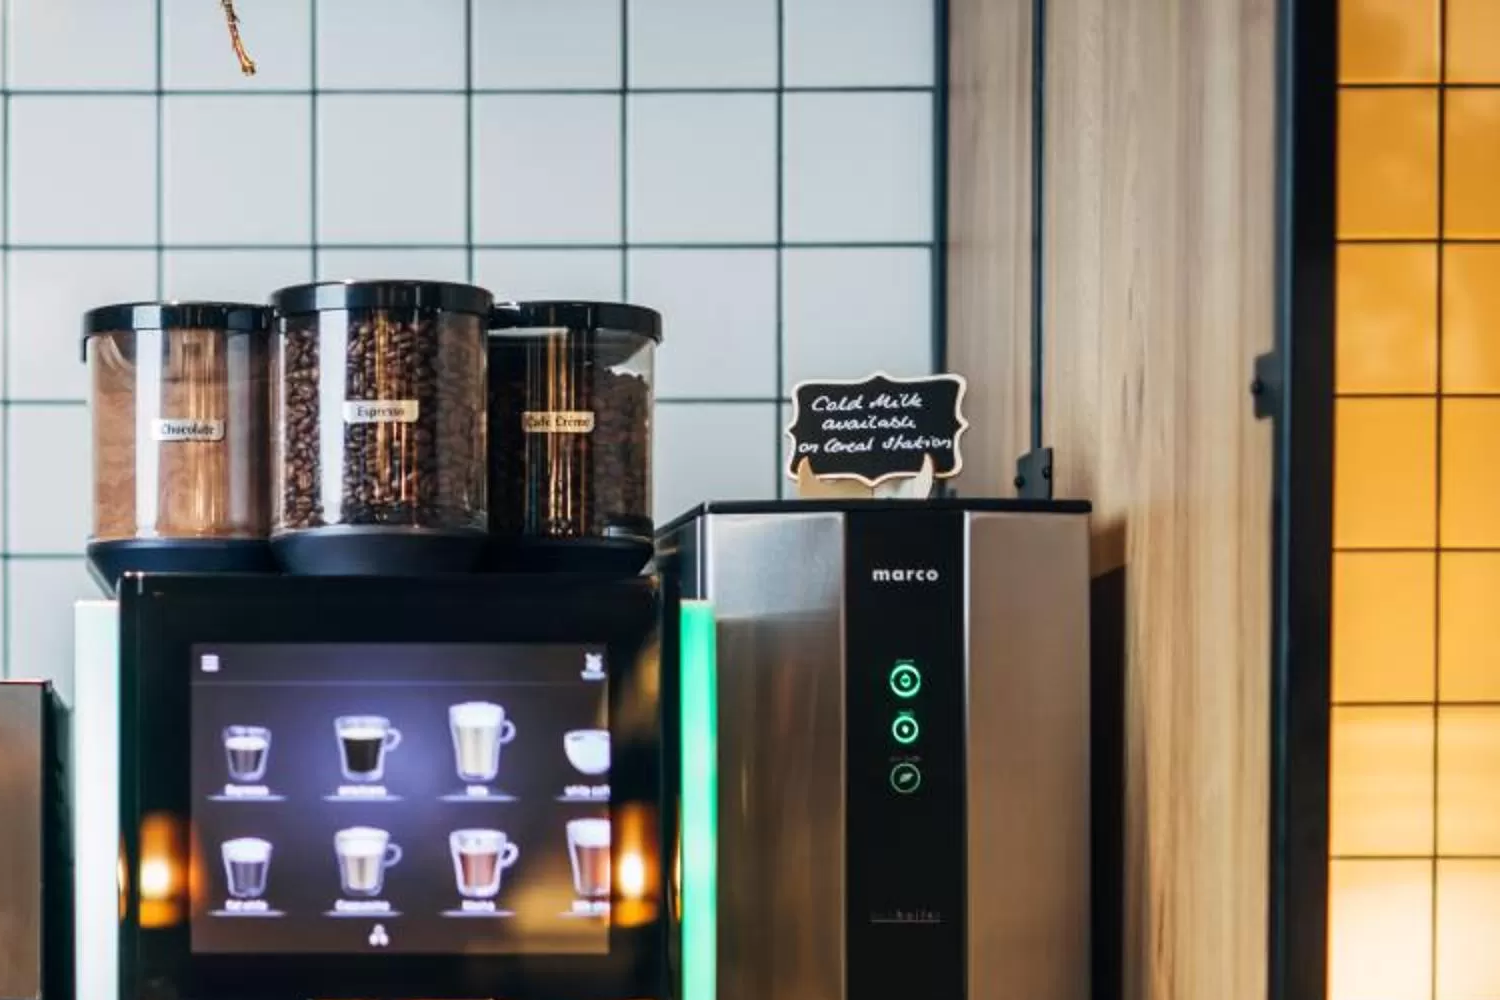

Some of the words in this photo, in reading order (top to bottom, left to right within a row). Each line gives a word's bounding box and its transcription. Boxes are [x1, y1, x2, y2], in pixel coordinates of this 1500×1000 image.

[811, 394, 864, 412] Cold
[868, 393, 924, 410] Milk
[357, 406, 405, 419] Espresso
[161, 422, 215, 435] Chocolate
[821, 415, 916, 431] available
[798, 443, 819, 453] on
[872, 568, 939, 581] marco
